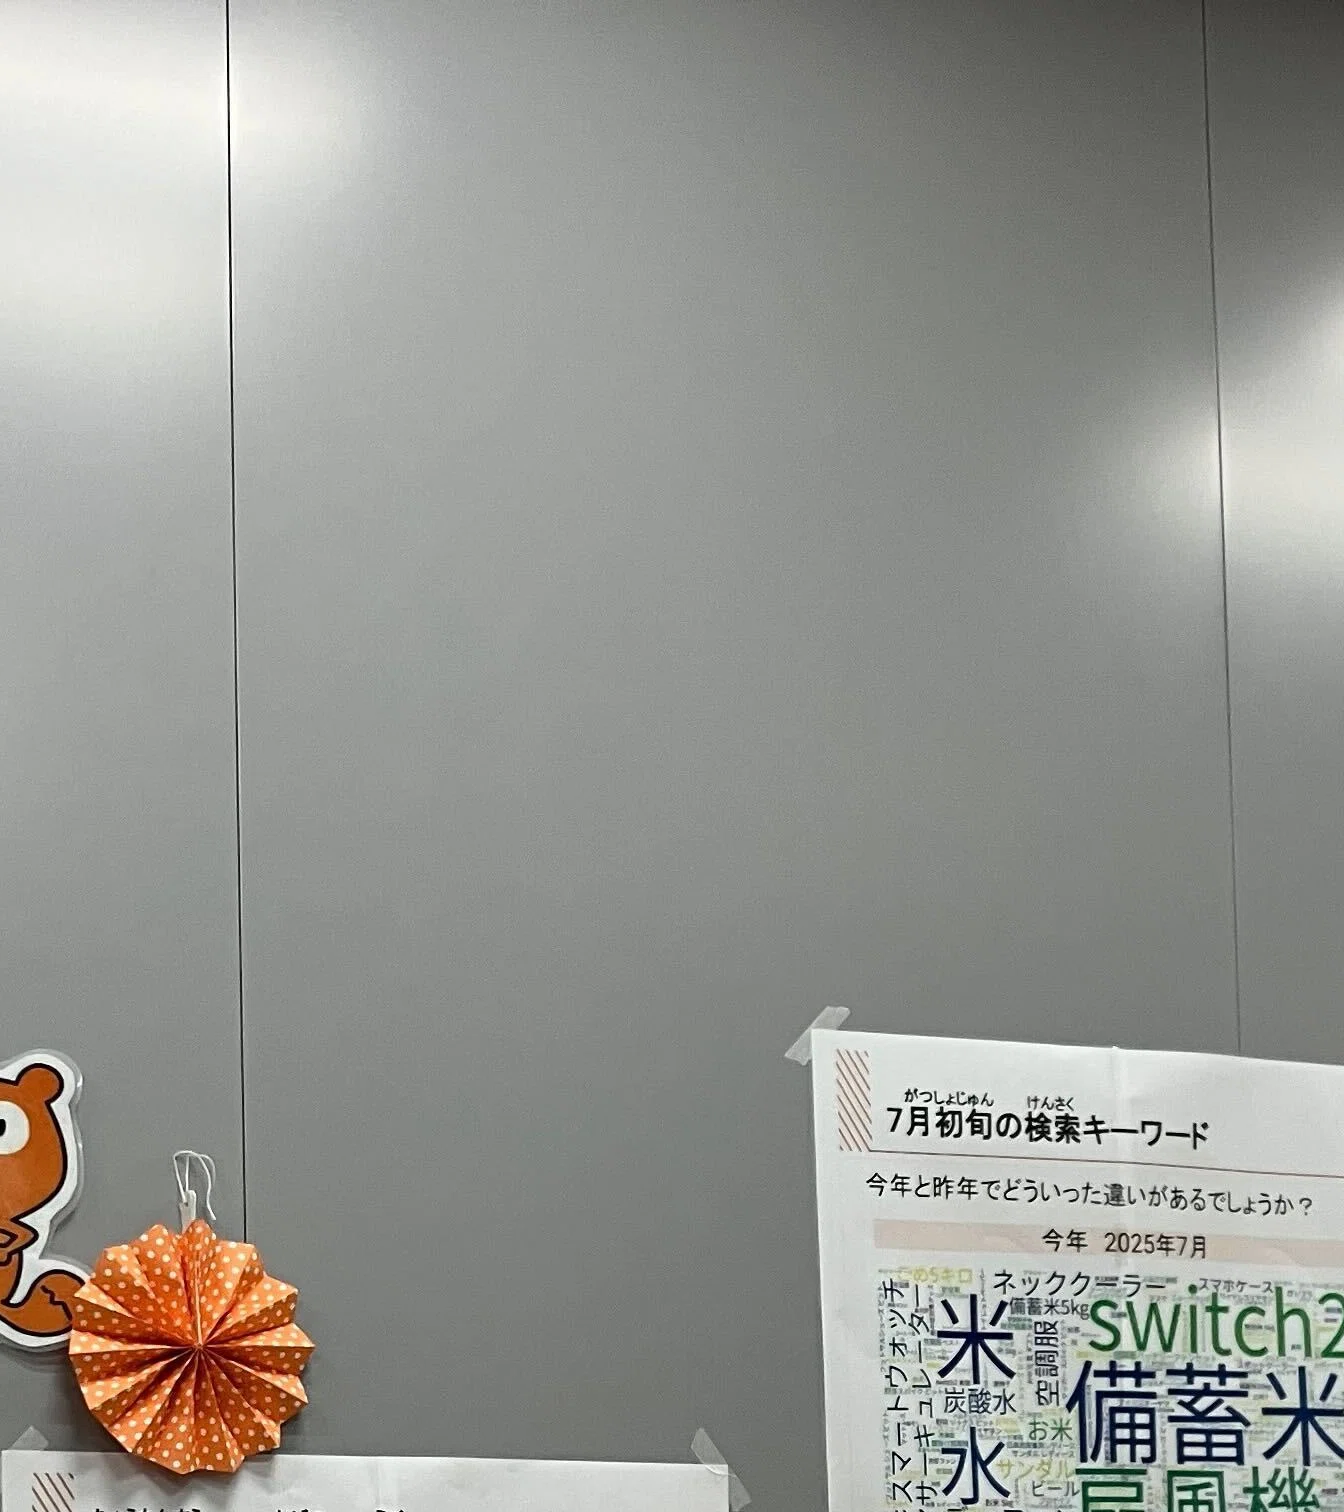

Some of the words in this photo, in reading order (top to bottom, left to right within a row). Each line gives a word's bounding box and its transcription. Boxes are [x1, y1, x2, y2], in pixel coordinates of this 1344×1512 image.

[904, 1088, 994, 1107] がつしょじゅん
[1026, 1096, 1075, 1111] けんさく
[886, 1106, 1210, 1151] 7月初旬の検索キーワード
[1041, 1229, 1088, 1251] 今年
[1104, 1232, 1207, 1259] 2025年7月
[993, 1269, 1166, 1297] ネッククーラー
[1199, 1278, 1273, 1293] スマホケース
[937, 1294, 1016, 1384] 米
[1034, 1320, 1060, 1406] 空調服
[944, 1388, 1016, 1415] 炭酸水
[1029, 1418, 1072, 1441] お米
[941, 1427, 1011, 1505] 水
[1032, 1481, 1079, 1498] ビール
